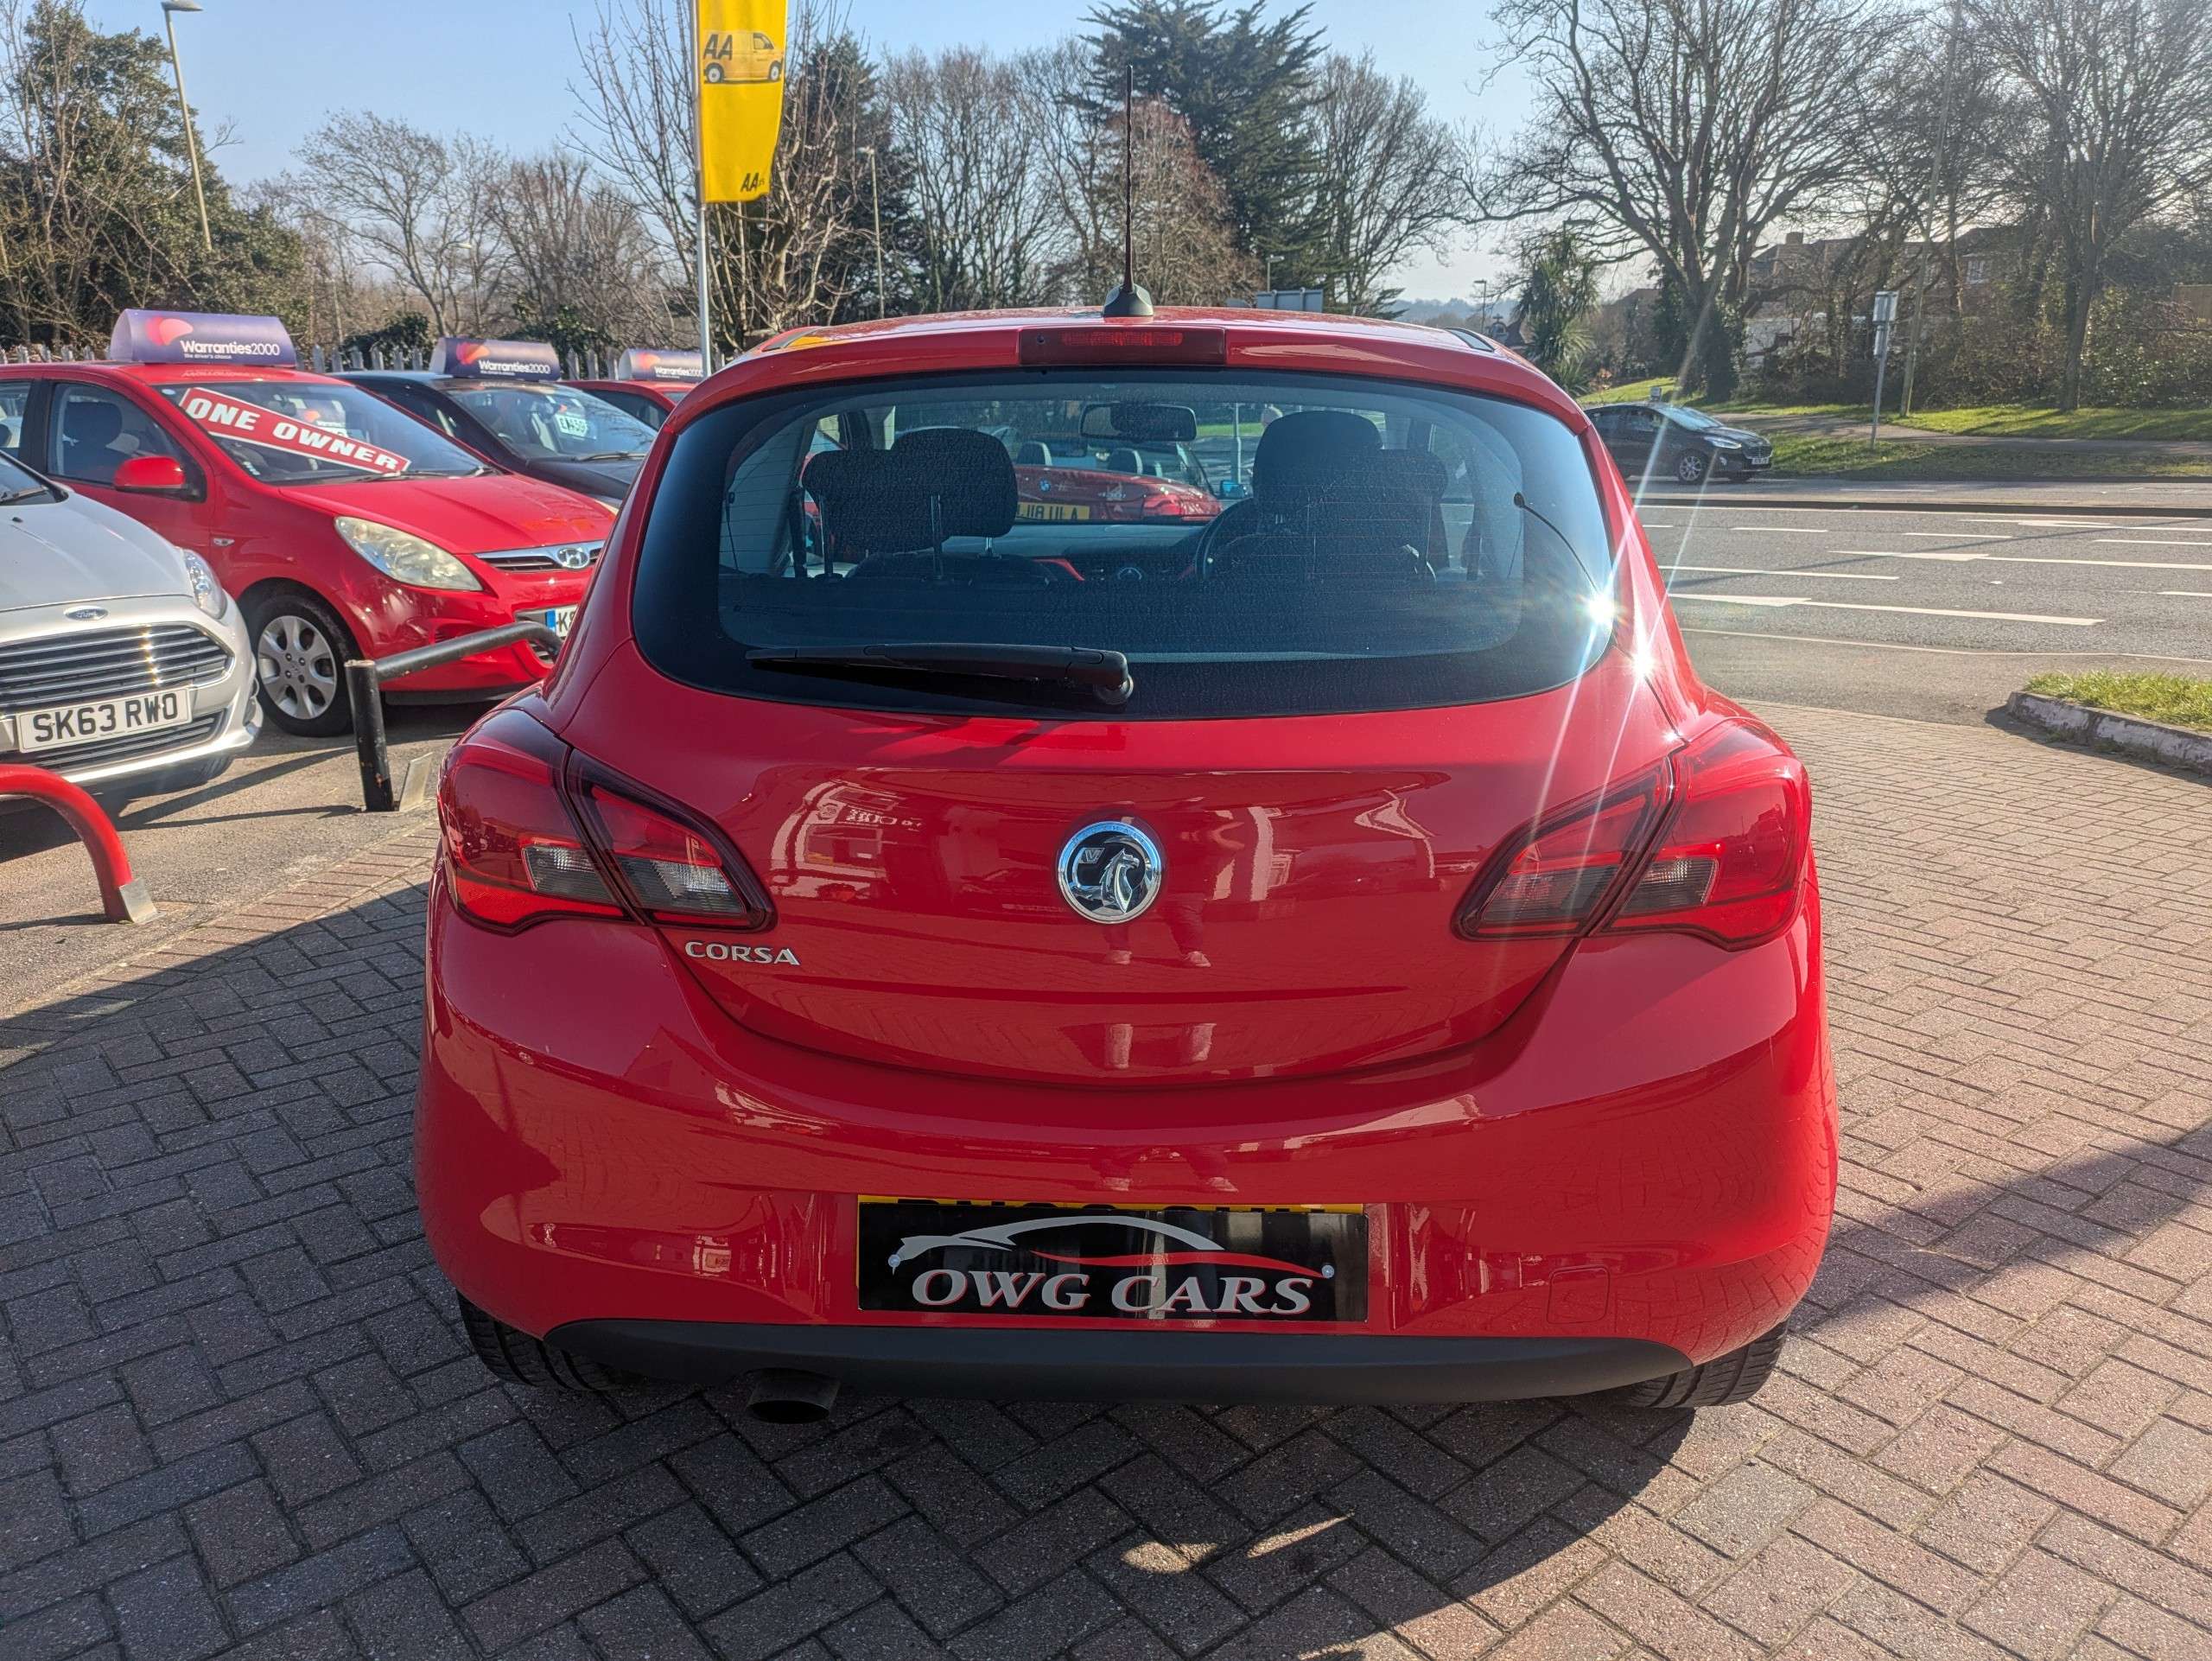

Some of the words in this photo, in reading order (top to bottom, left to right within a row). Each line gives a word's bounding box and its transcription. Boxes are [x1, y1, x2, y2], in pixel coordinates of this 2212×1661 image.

[702, 34, 733, 60] AA
[740, 172, 760, 192] AA
[180, 340, 280, 356] Warranties2000
[478, 360, 551, 375] Warranties2000
[185, 397, 261, 431] ONE
[272, 421, 400, 471] OWNER
[33, 703, 117, 742] SK63
[124, 692, 179, 728] RWO
[685, 941, 800, 966] CORSA
[912, 1268, 1092, 1309] OWG
[1111, 1273, 1313, 1315] CARS
